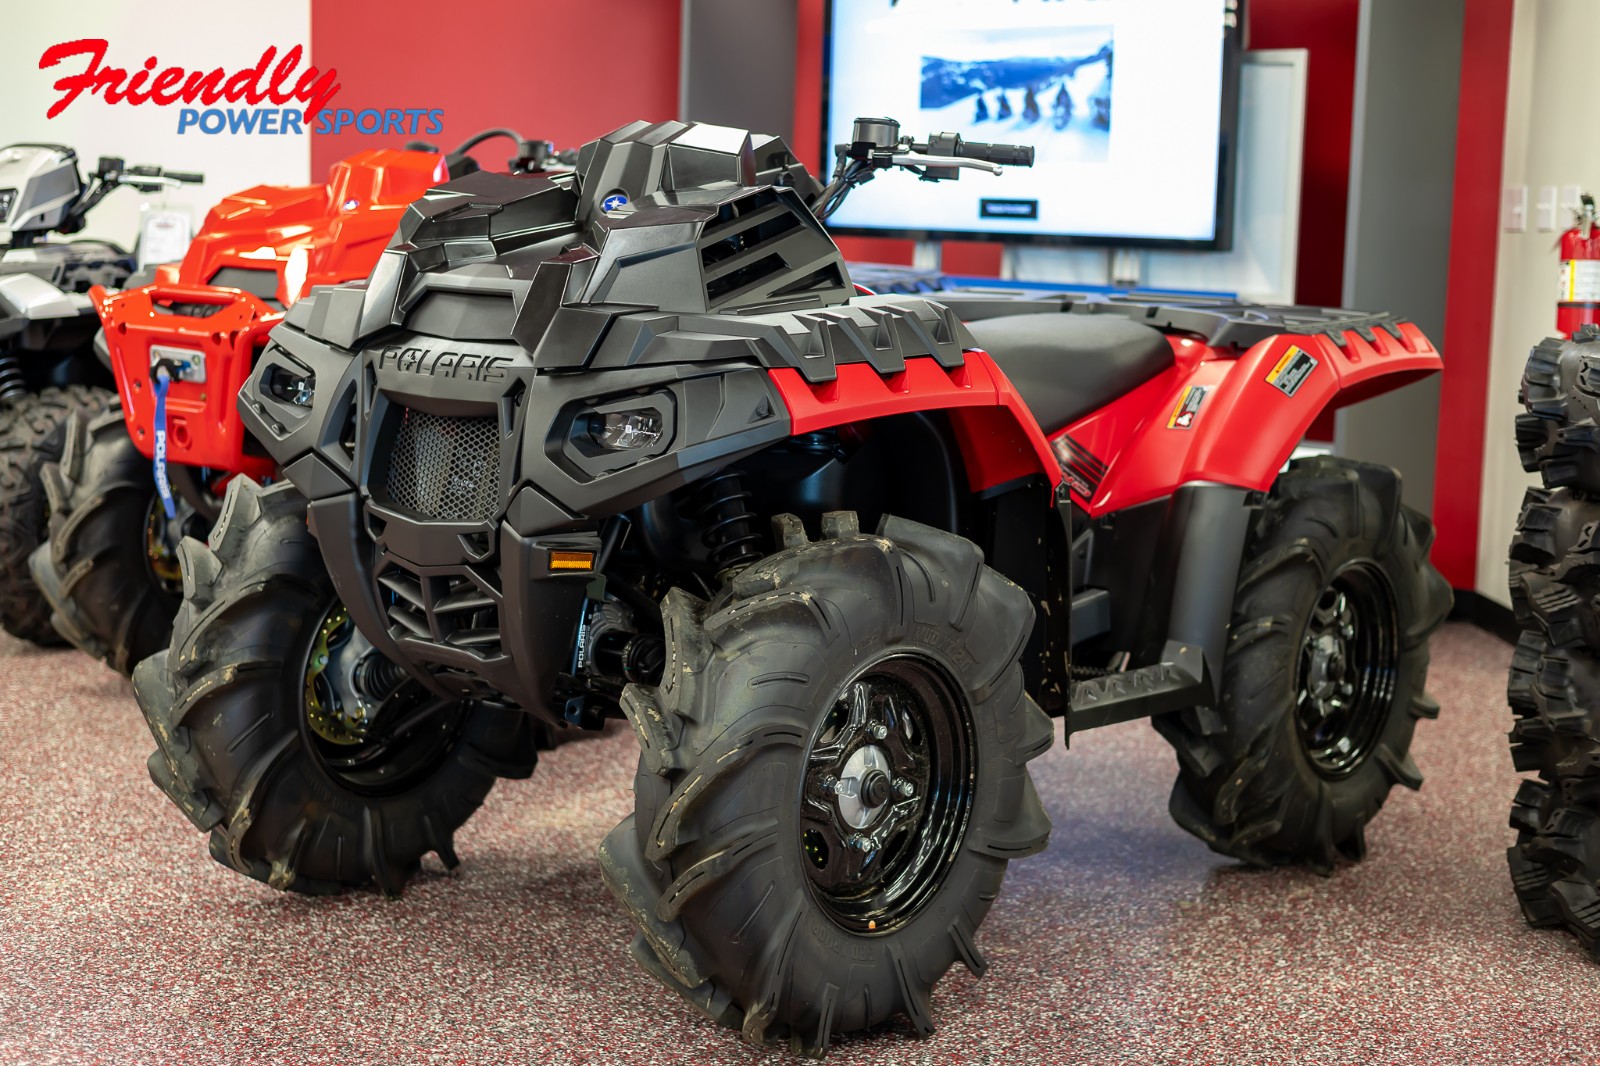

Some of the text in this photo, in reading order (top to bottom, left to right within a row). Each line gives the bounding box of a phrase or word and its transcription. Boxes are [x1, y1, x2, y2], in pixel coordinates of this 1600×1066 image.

[378, 345, 514, 384] POLARIS
[155, 430, 171, 499] POLARIS
[577, 624, 587, 668] POLARIS
